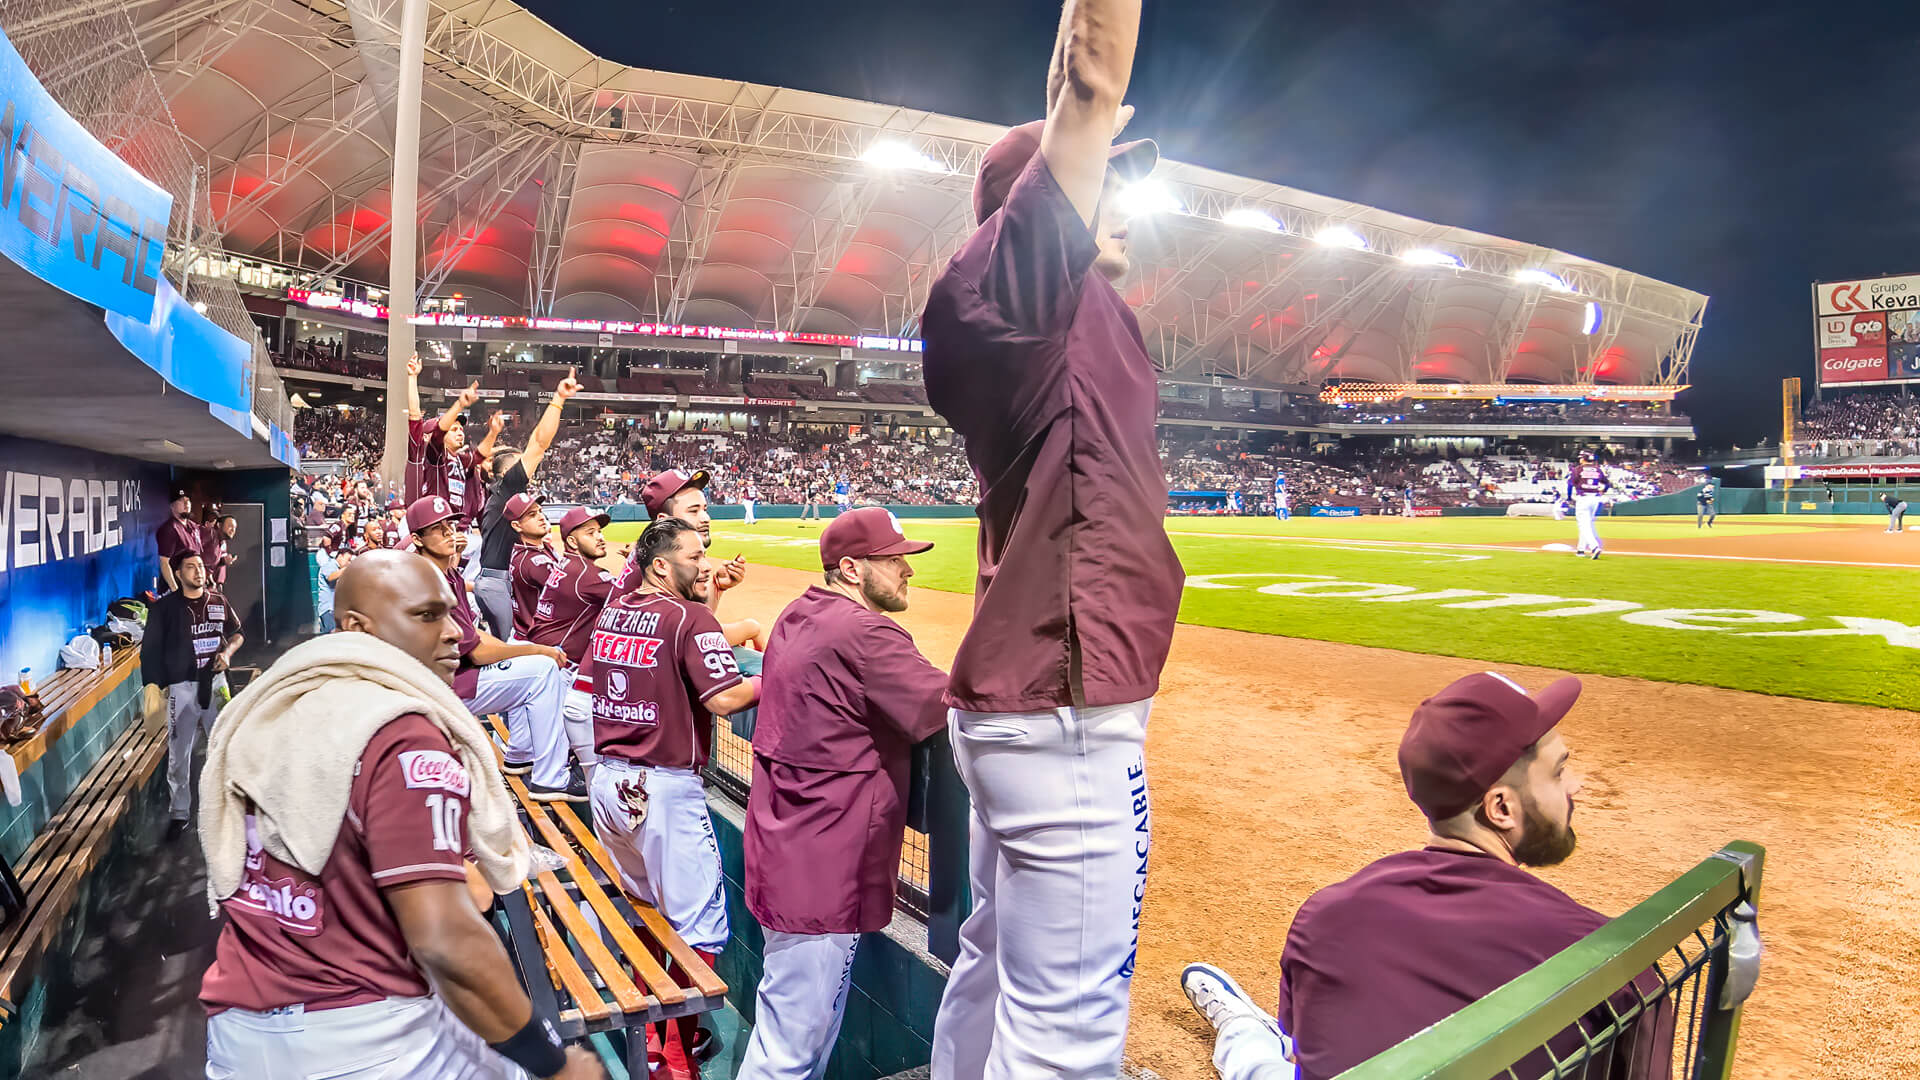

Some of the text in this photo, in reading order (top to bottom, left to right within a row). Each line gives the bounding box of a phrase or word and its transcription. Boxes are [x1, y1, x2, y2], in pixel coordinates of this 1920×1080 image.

[1871, 283, 1907, 294] Grupo
[1872, 294, 1920, 310] Keva
[1824, 357, 1883, 372] Colgate
[597, 607, 661, 635] AMEZAGA
[593, 633, 661, 665] TECATE
[703, 652, 740, 679] 99
[425, 793, 462, 855] 10
